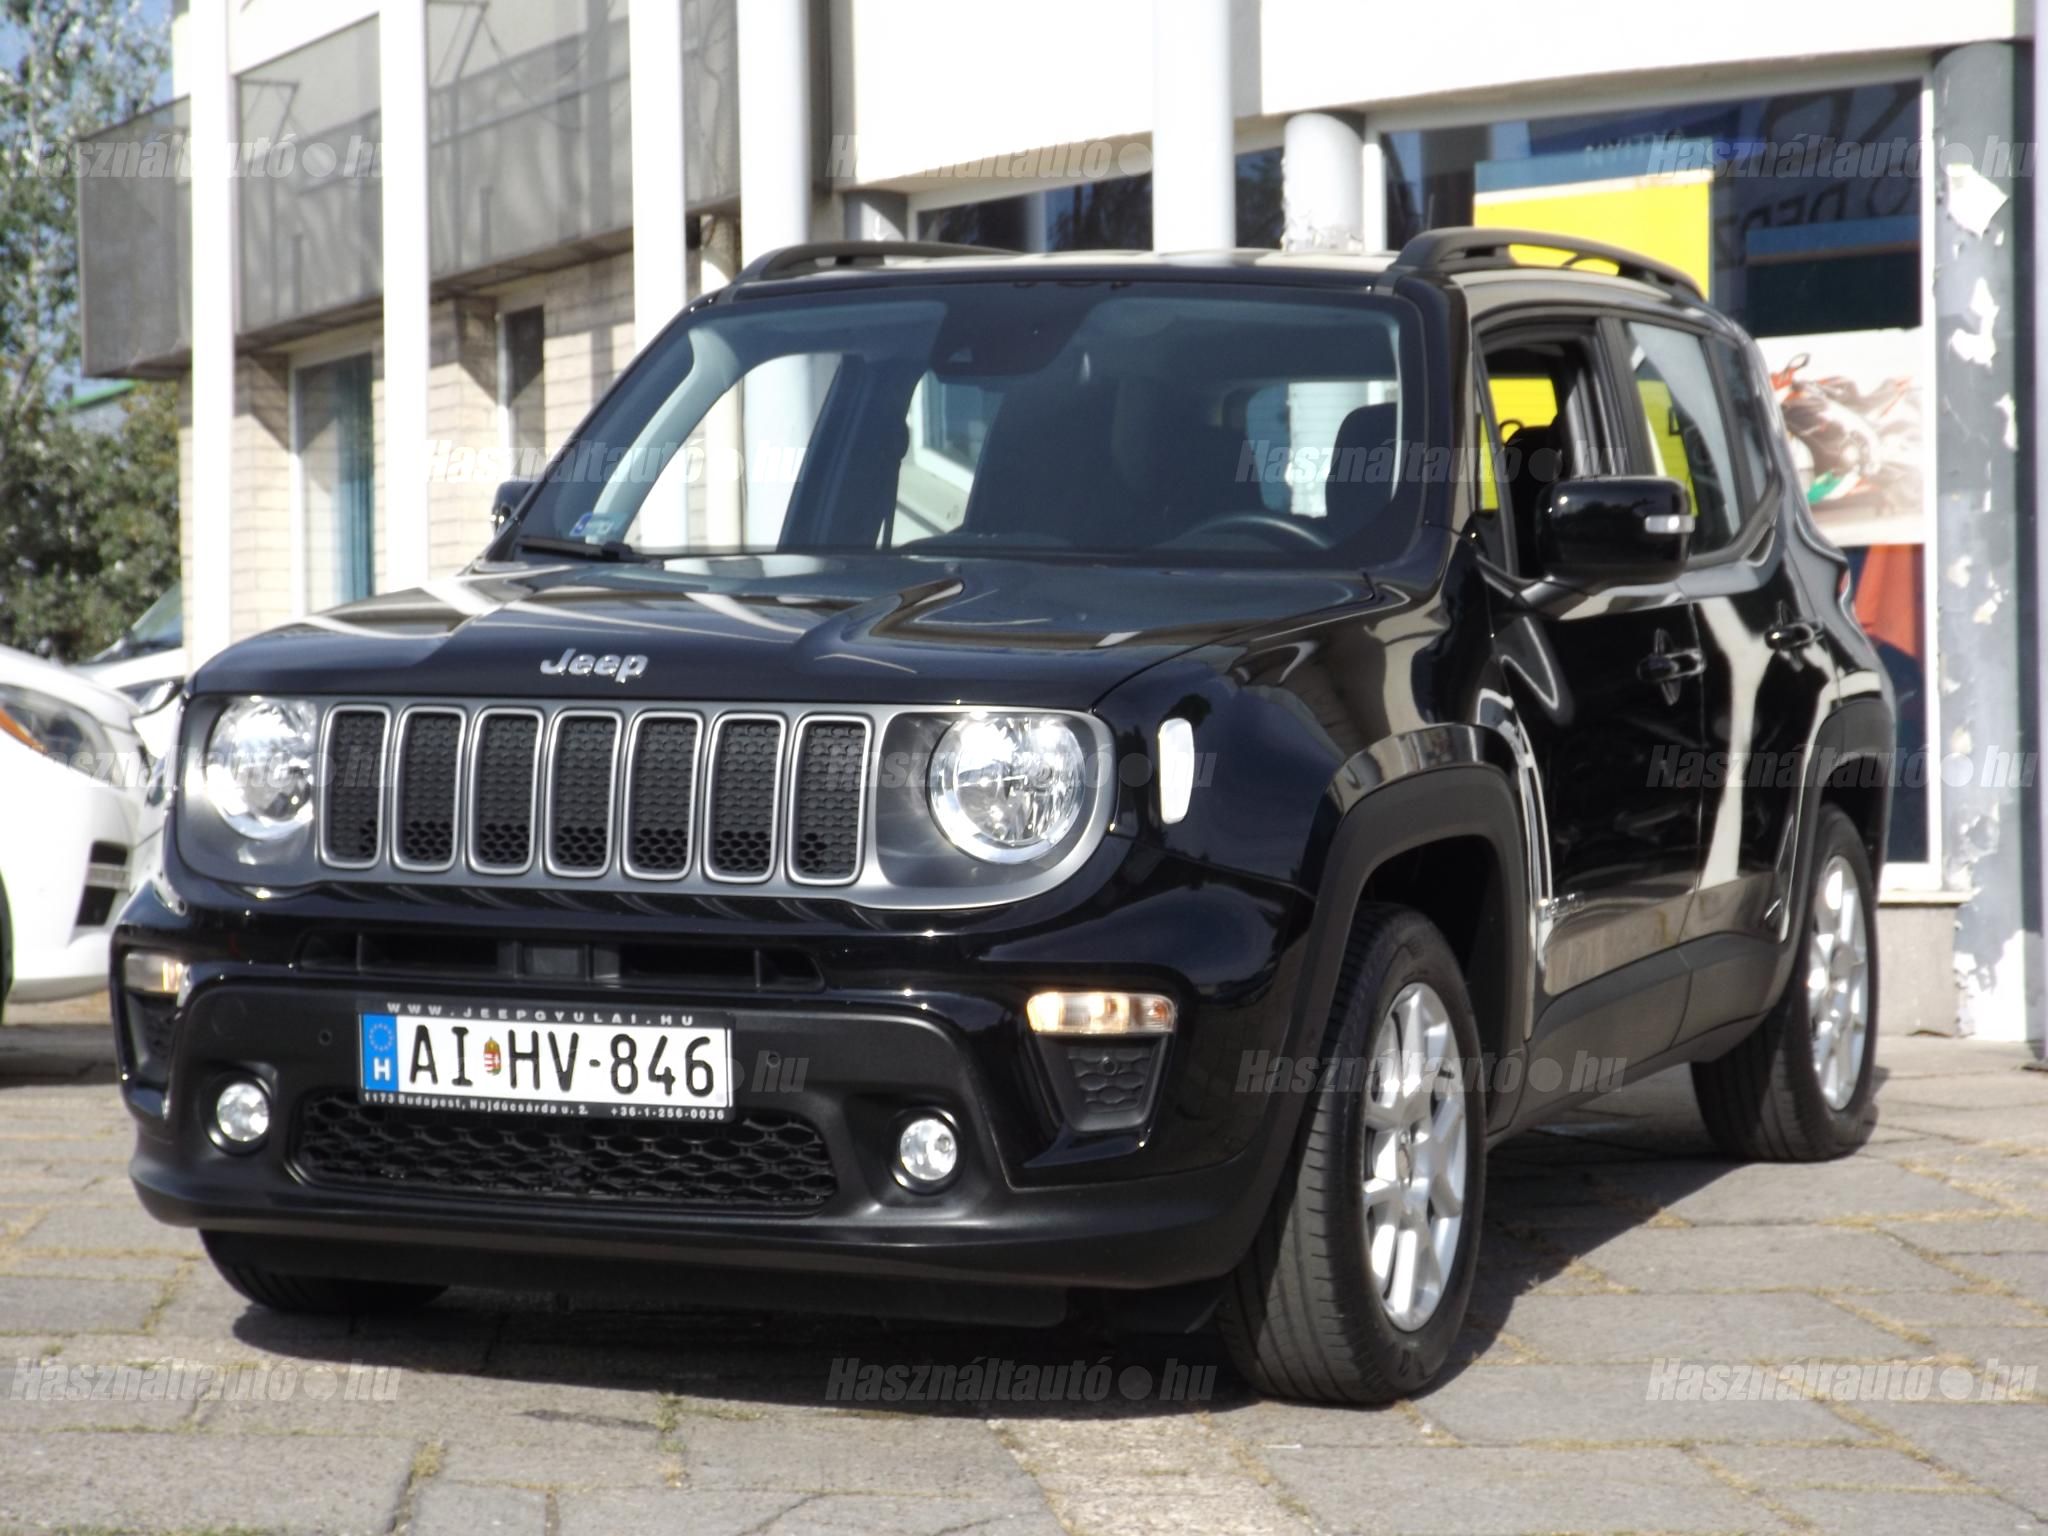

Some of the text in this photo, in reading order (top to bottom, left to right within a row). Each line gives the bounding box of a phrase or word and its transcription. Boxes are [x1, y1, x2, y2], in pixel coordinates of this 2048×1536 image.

[540, 648, 648, 683] Jeep
[373, 1057, 391, 1081] H
[364, 1092, 394, 1104] 1173
